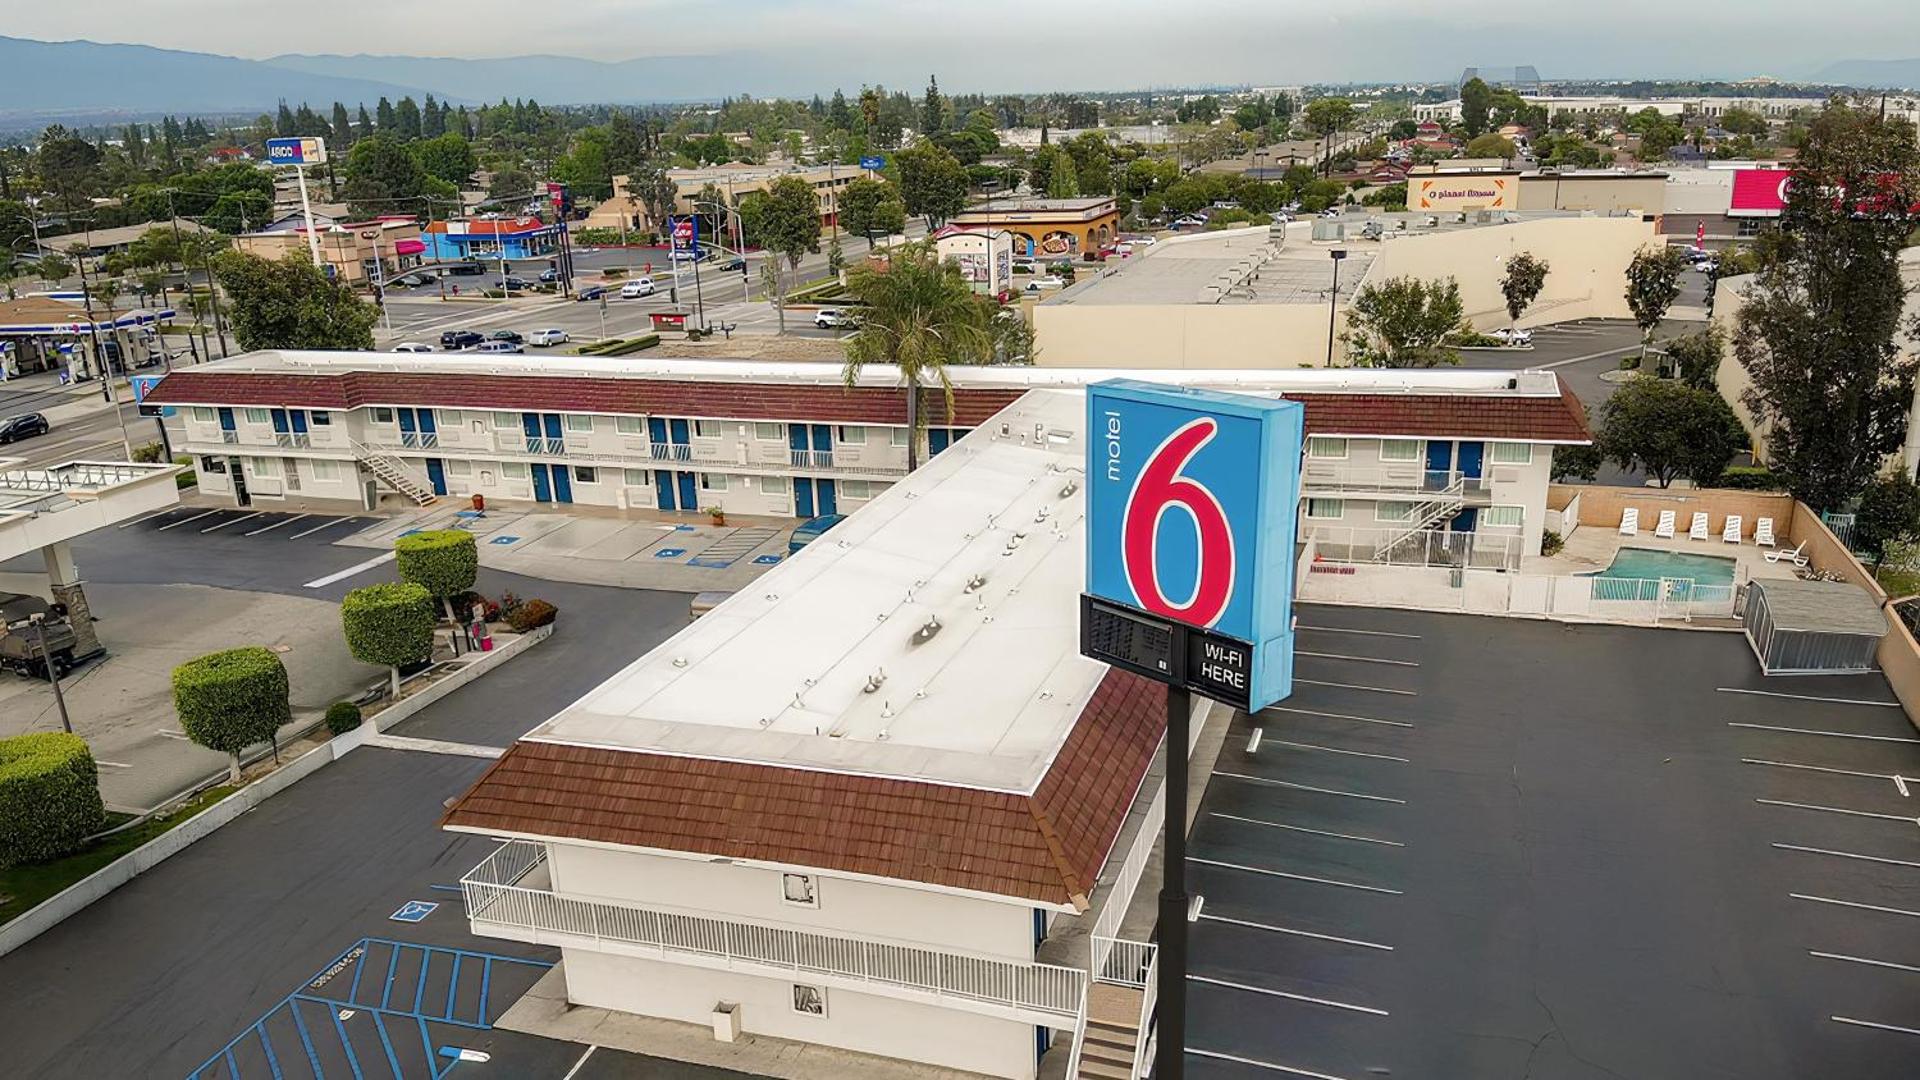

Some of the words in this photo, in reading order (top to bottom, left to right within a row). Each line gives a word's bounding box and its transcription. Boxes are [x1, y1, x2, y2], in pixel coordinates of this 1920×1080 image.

[1105, 411, 1121, 481] motel
[1121, 416, 1236, 629] 6
[1201, 661, 1245, 690] HERE
[1204, 642, 1244, 668] WI-FI
